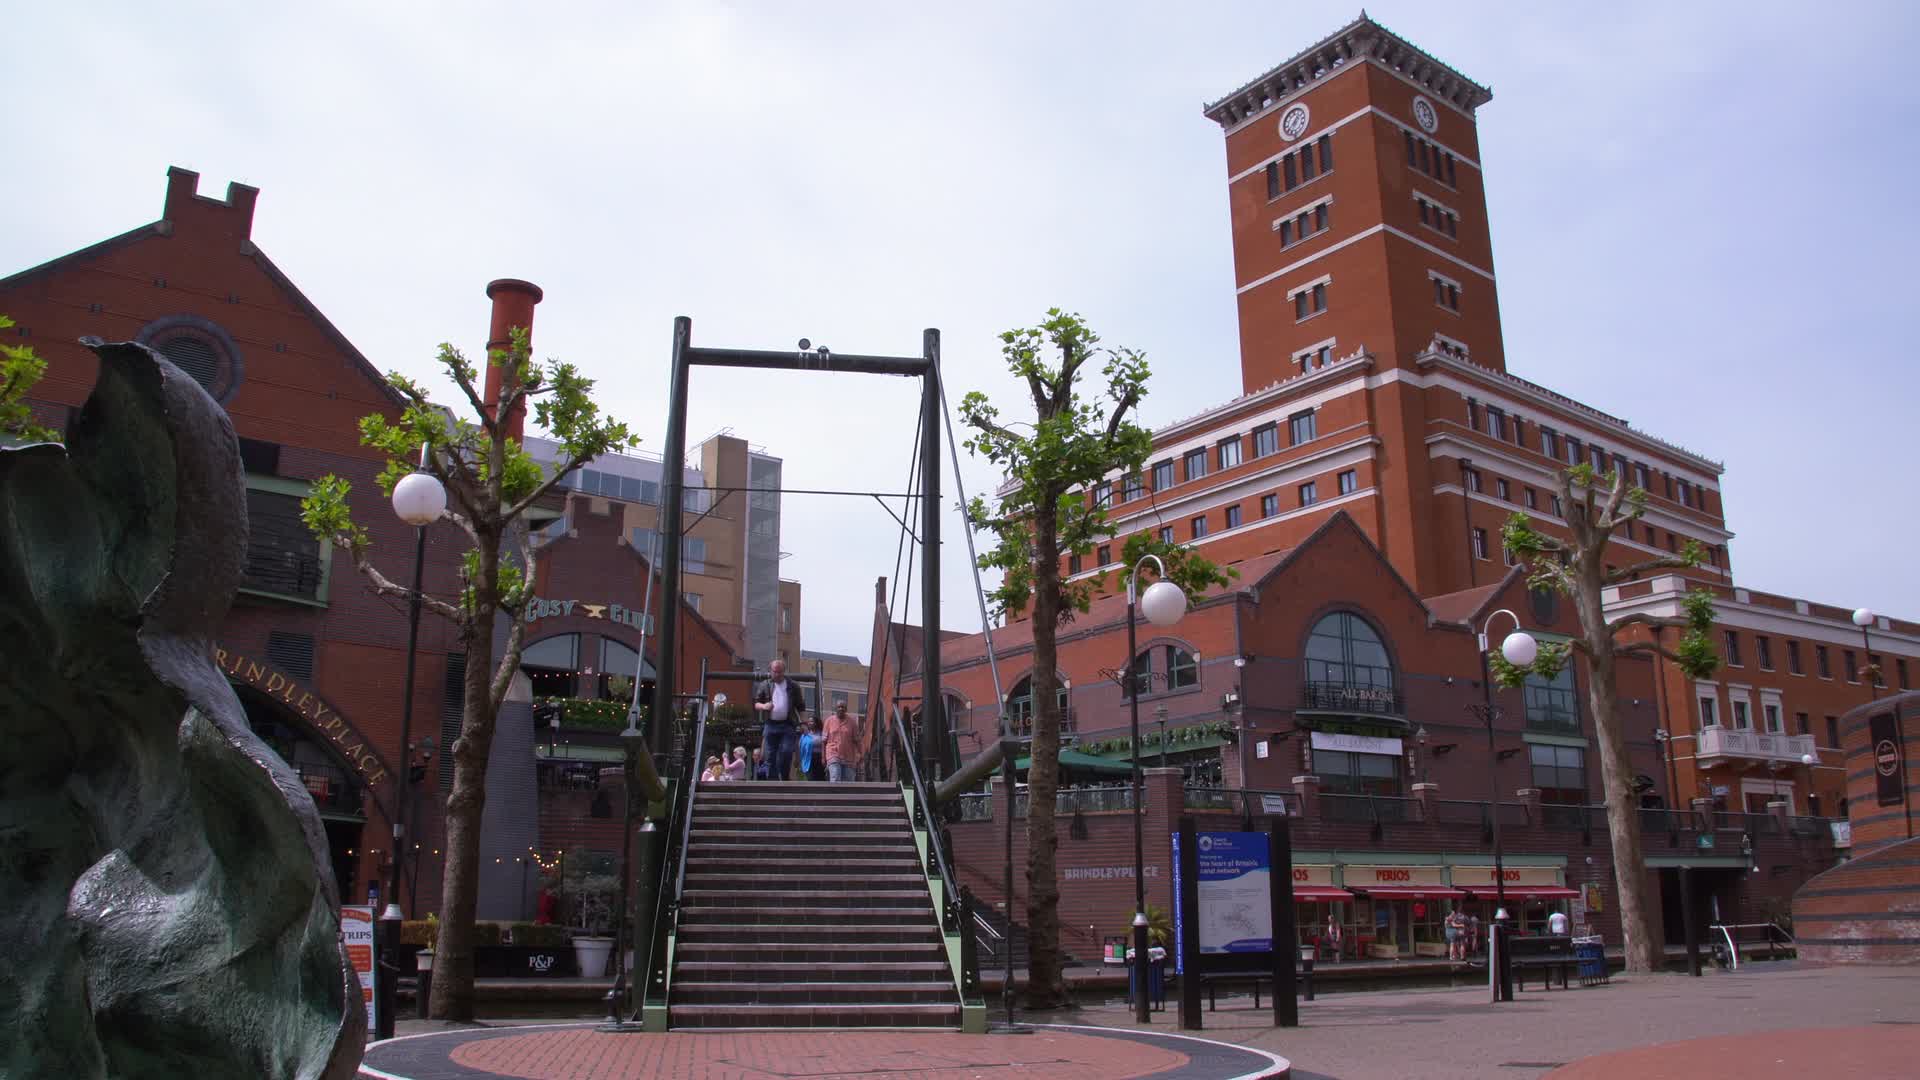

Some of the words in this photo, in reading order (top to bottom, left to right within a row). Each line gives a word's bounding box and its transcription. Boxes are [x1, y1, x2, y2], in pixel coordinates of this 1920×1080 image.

[526, 597, 579, 623] COSY
[215, 647, 386, 785] RINDLEYPLACE
[1064, 866, 1160, 880] BRINDLEYPLCE
[1490, 870, 1521, 882] PRIOS
[529, 954, 554, 969] P&P
